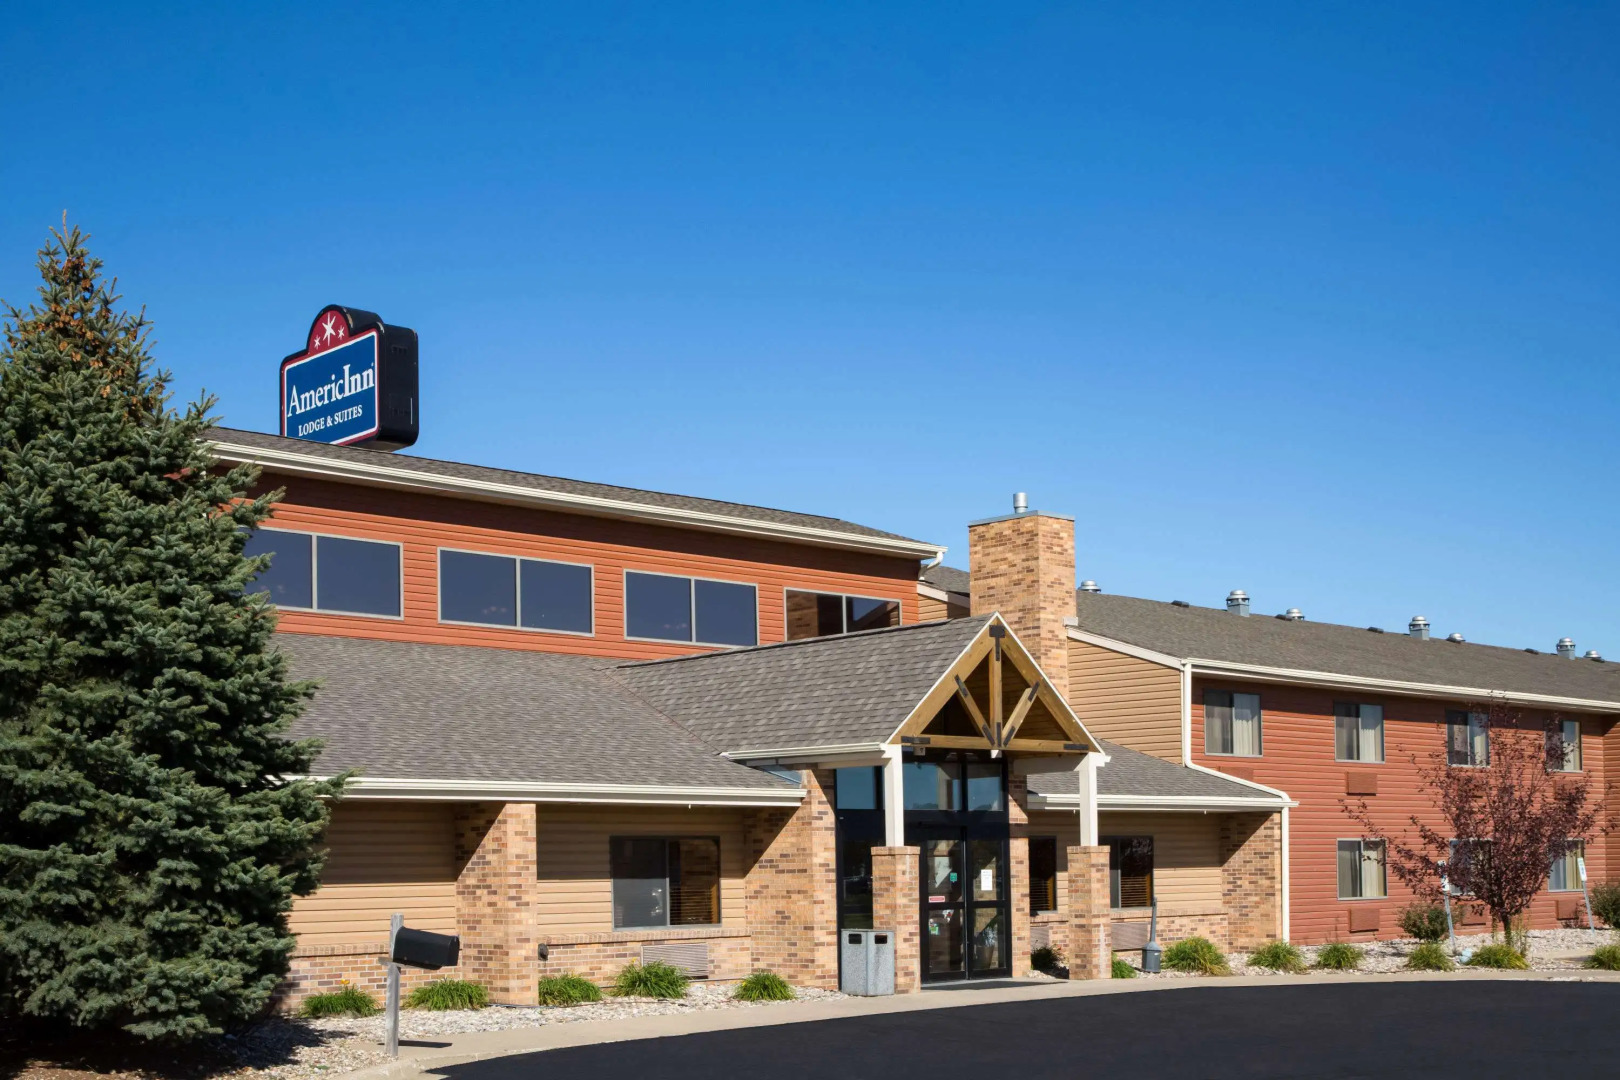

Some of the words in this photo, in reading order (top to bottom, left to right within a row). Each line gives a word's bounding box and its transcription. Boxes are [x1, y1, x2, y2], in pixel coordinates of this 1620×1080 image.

[287, 363, 374, 417] AmericInn
[298, 417, 325, 437] LODGE
[326, 415, 333, 427] &
[334, 404, 363, 425] SUITES
